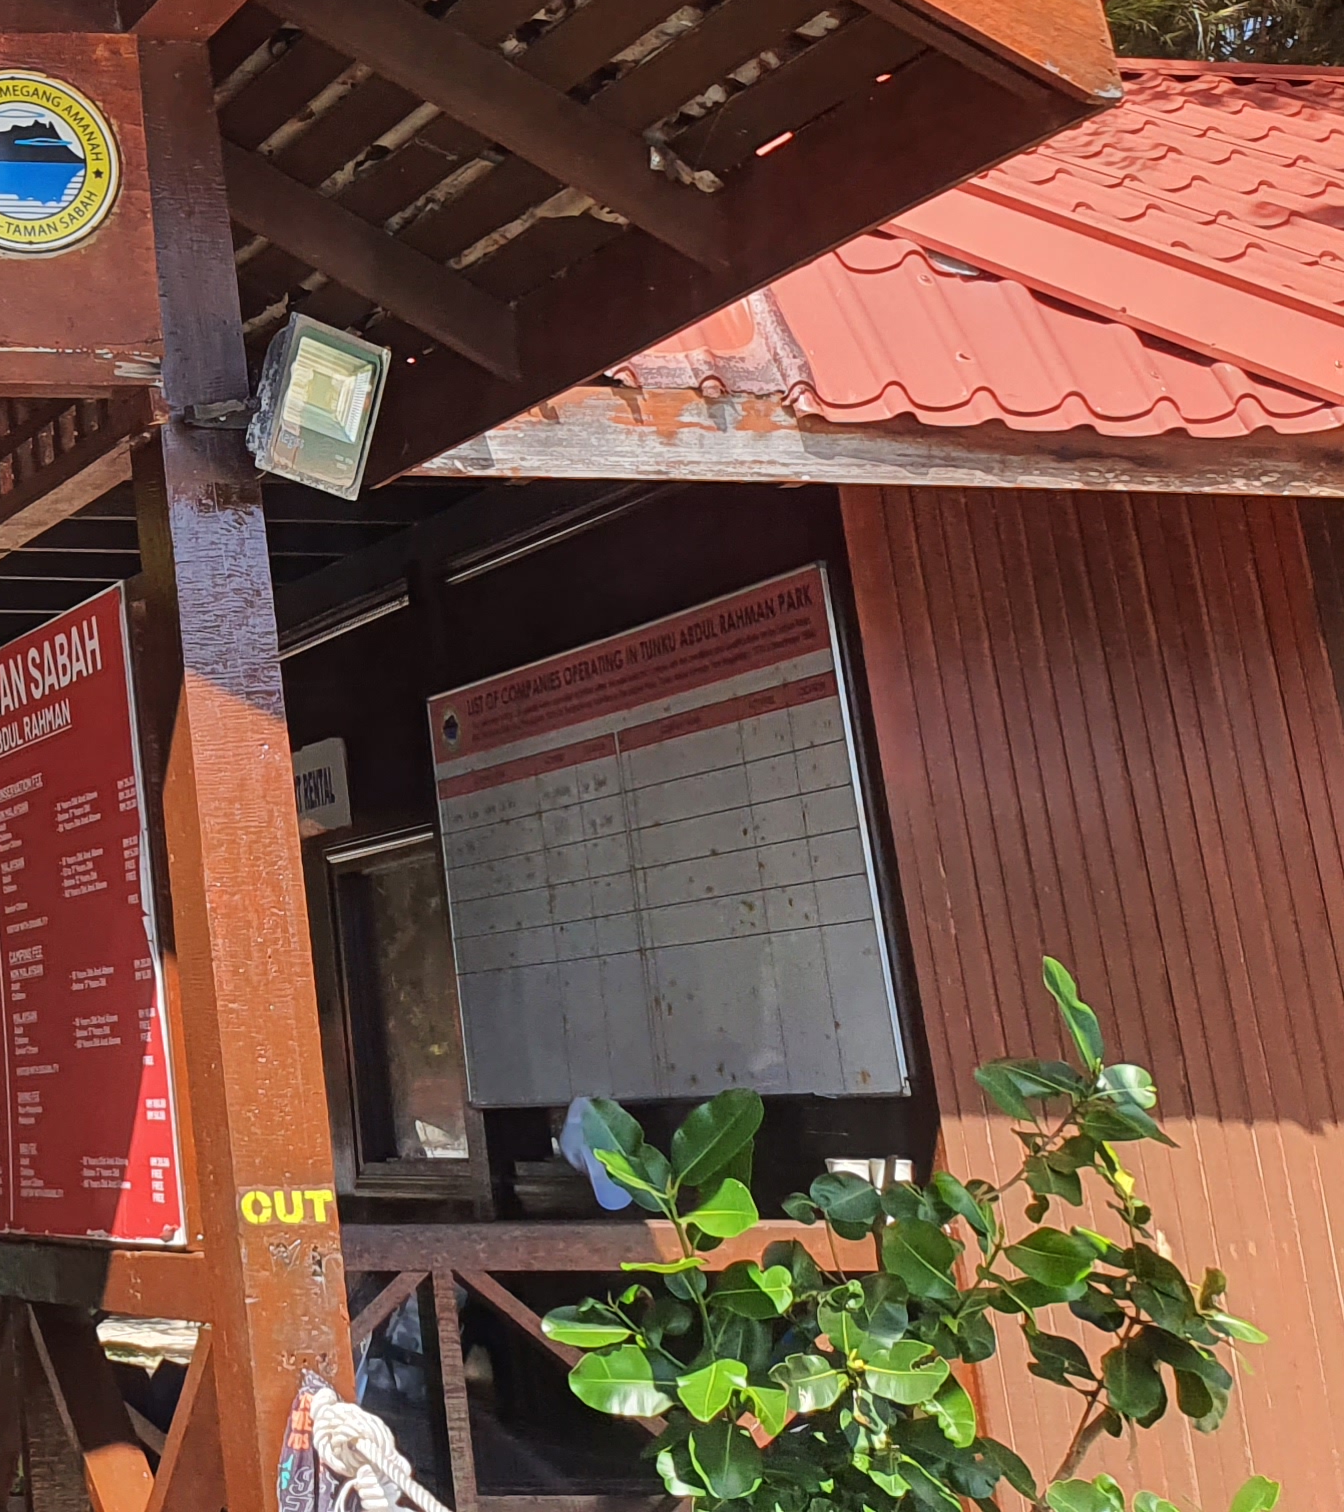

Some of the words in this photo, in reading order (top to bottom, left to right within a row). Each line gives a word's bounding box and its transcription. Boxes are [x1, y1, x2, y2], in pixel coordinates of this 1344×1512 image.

[63, 104, 103, 162] AMANAH
[60, 190, 97, 230] SABAH
[27, 615, 102, 700] SABAH
[563, 650, 623, 686] OPERATING
[640, 631, 676, 661] TUNKU
[680, 618, 718, 648] ABDUL
[719, 598, 777, 634] RAHMAN
[778, 584, 813, 613] PARK
[23, 698, 72, 743] RAHMAN
[240, 1189, 334, 1225] OUT
